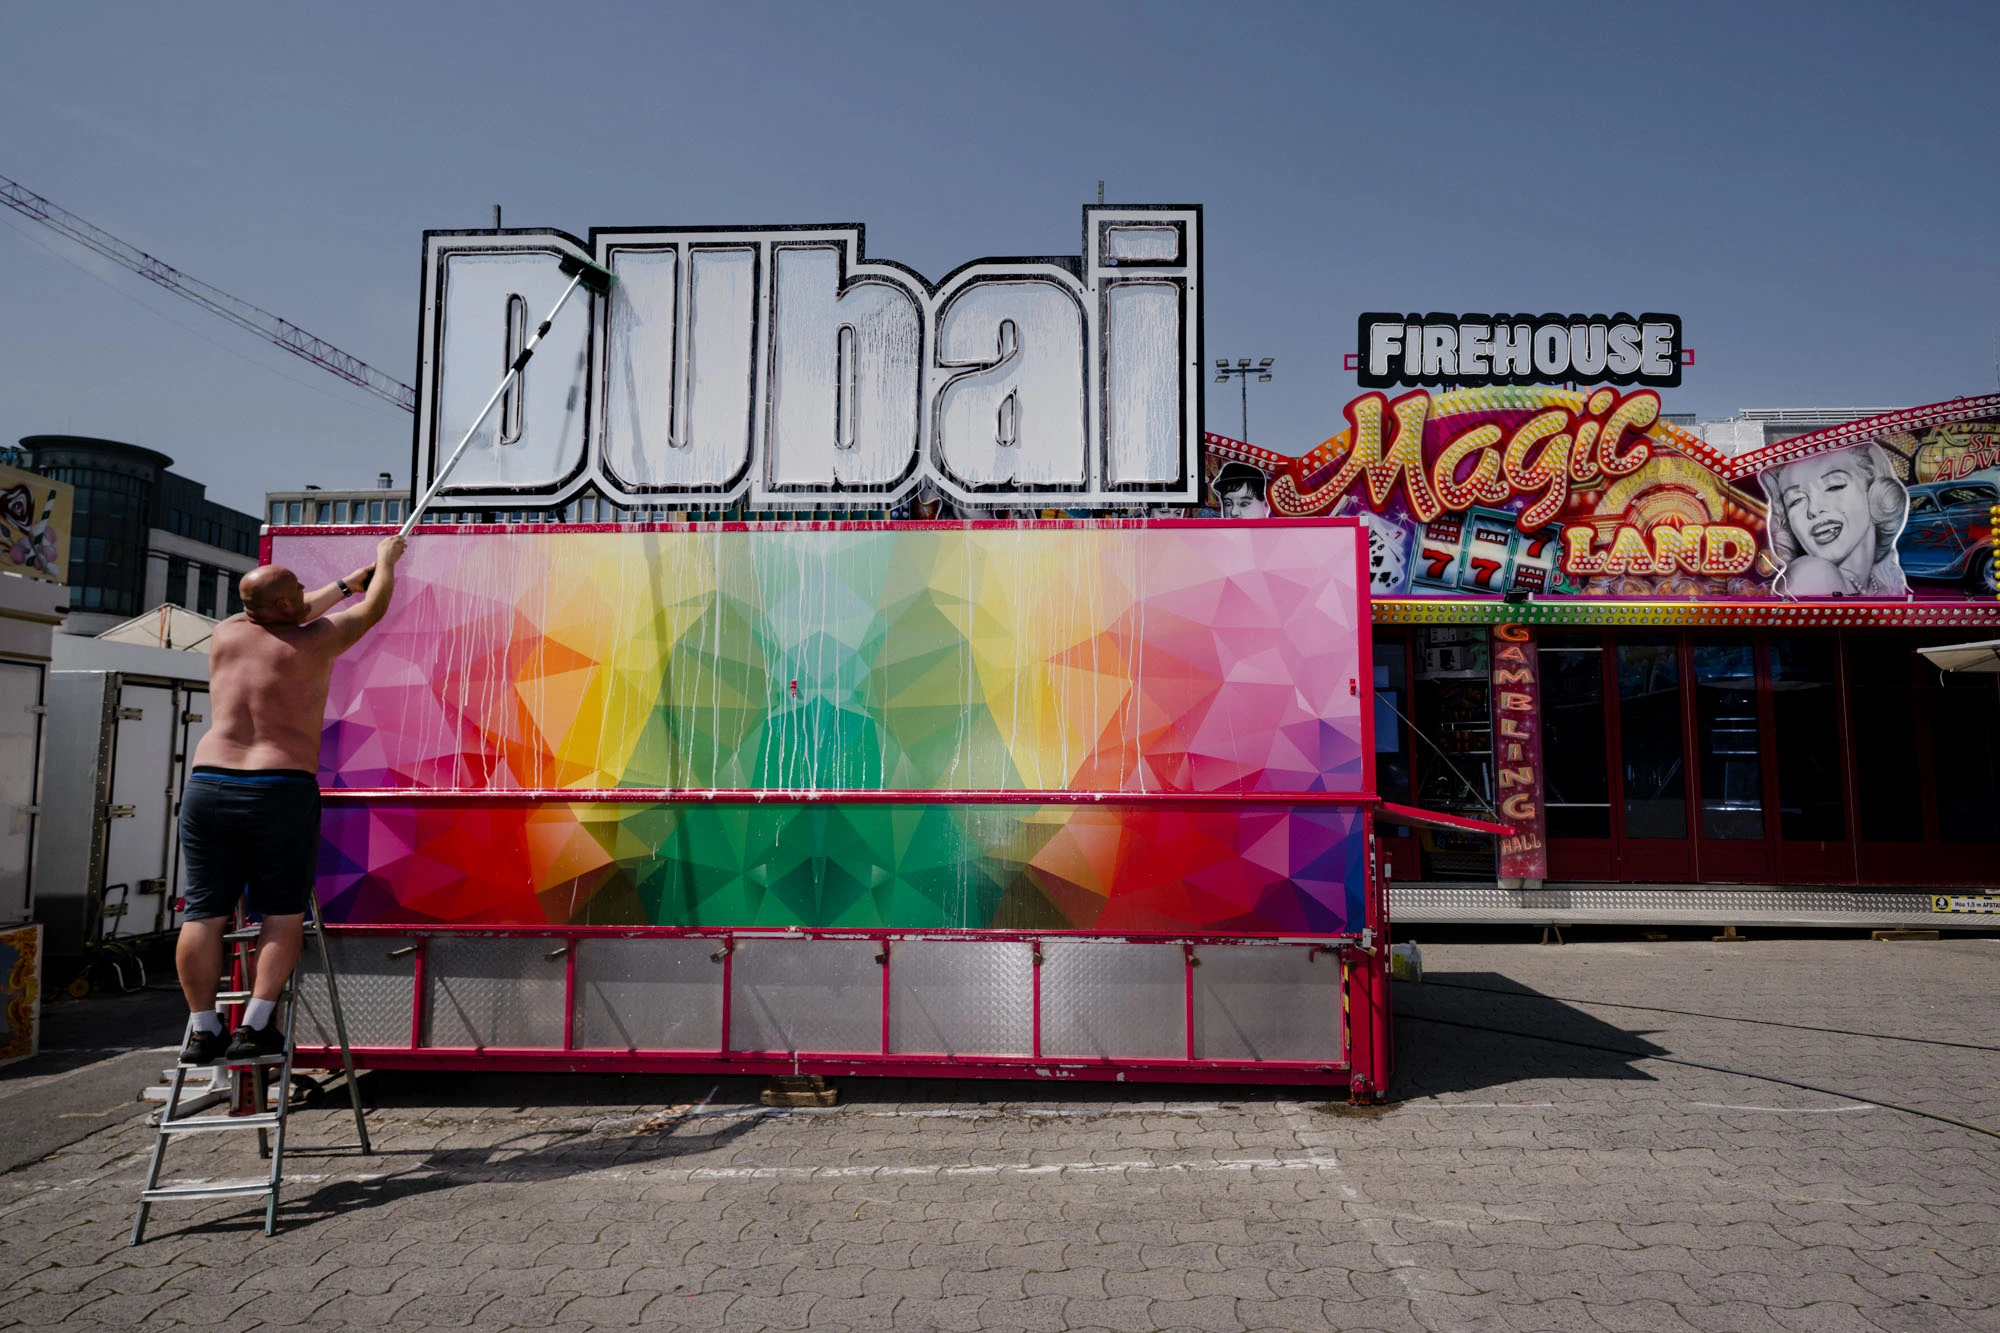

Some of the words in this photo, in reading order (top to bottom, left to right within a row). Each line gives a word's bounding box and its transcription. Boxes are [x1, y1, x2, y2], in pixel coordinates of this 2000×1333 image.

[1369, 323, 1675, 376] FIREHOUSE
[1268, 389, 1660, 529] Magic
[1933, 449, 2000, 482] ADV
[1480, 530, 1506, 543] BAR
[1523, 532, 1552, 558] 7
[1566, 524, 1757, 575] LAND
[1422, 548, 1454, 579] 7
[1471, 557, 1502, 587] 7
[1493, 623, 1535, 819] GAMBLING
[1501, 833, 1542, 856] HALL
